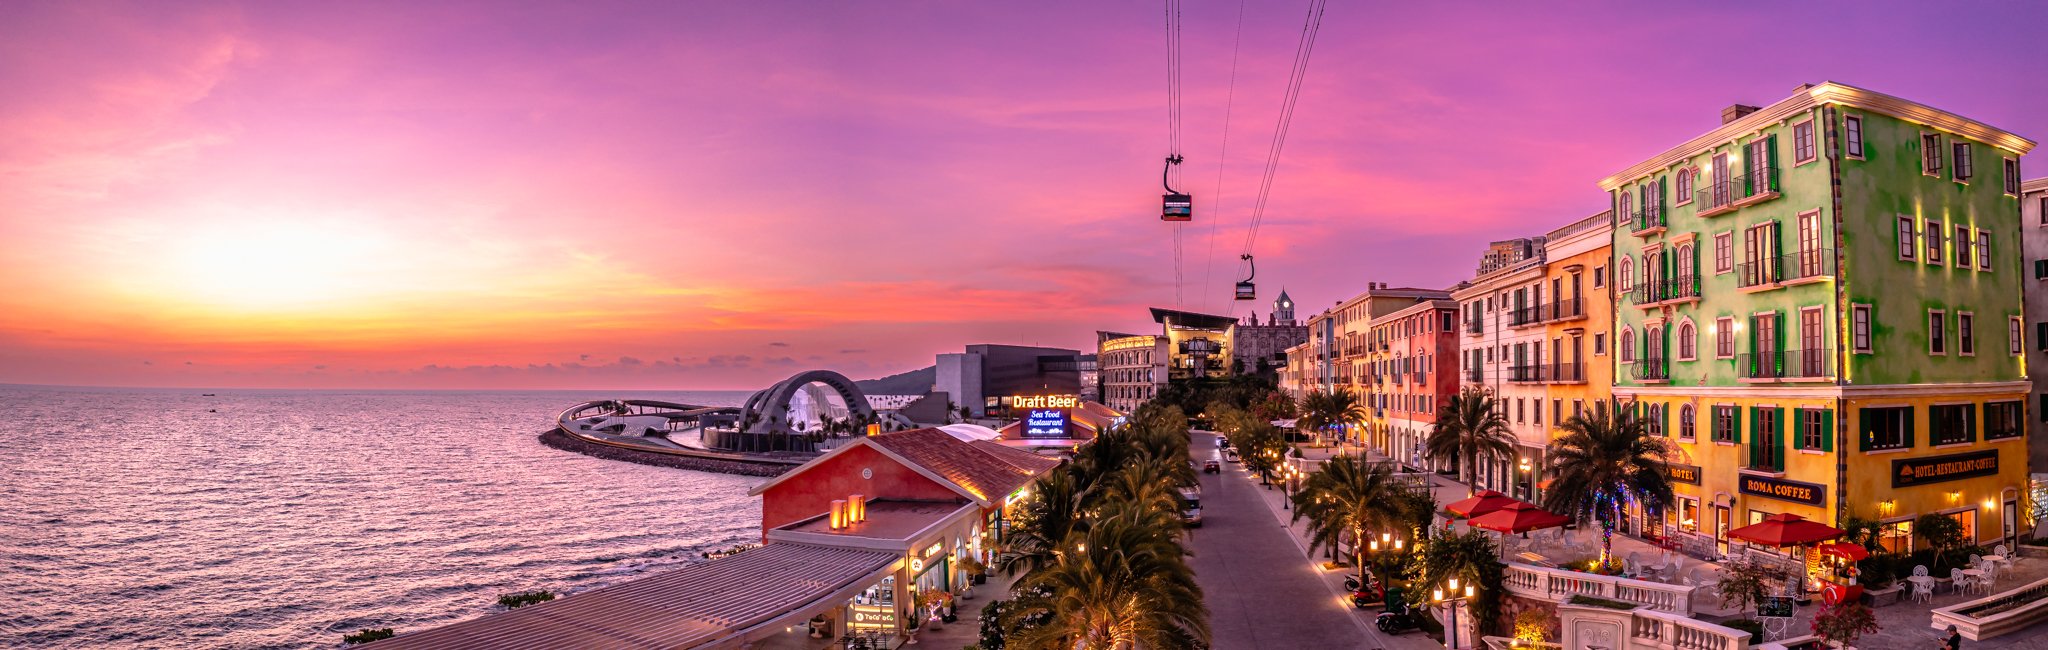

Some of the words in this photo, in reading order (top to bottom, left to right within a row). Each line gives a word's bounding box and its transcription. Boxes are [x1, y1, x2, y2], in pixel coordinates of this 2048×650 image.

[1013, 395, 1046, 408] Draft
[1047, 395, 1077, 408] Beer
[1031, 410, 1043, 418] Sea
[1044, 410, 1060, 418] Food
[1028, 418, 1063, 426] Restaurant
[1671, 468, 1695, 480] HOTEL
[1747, 479, 1773, 494] ROMA
[1775, 484, 1812, 500] COFFEE
